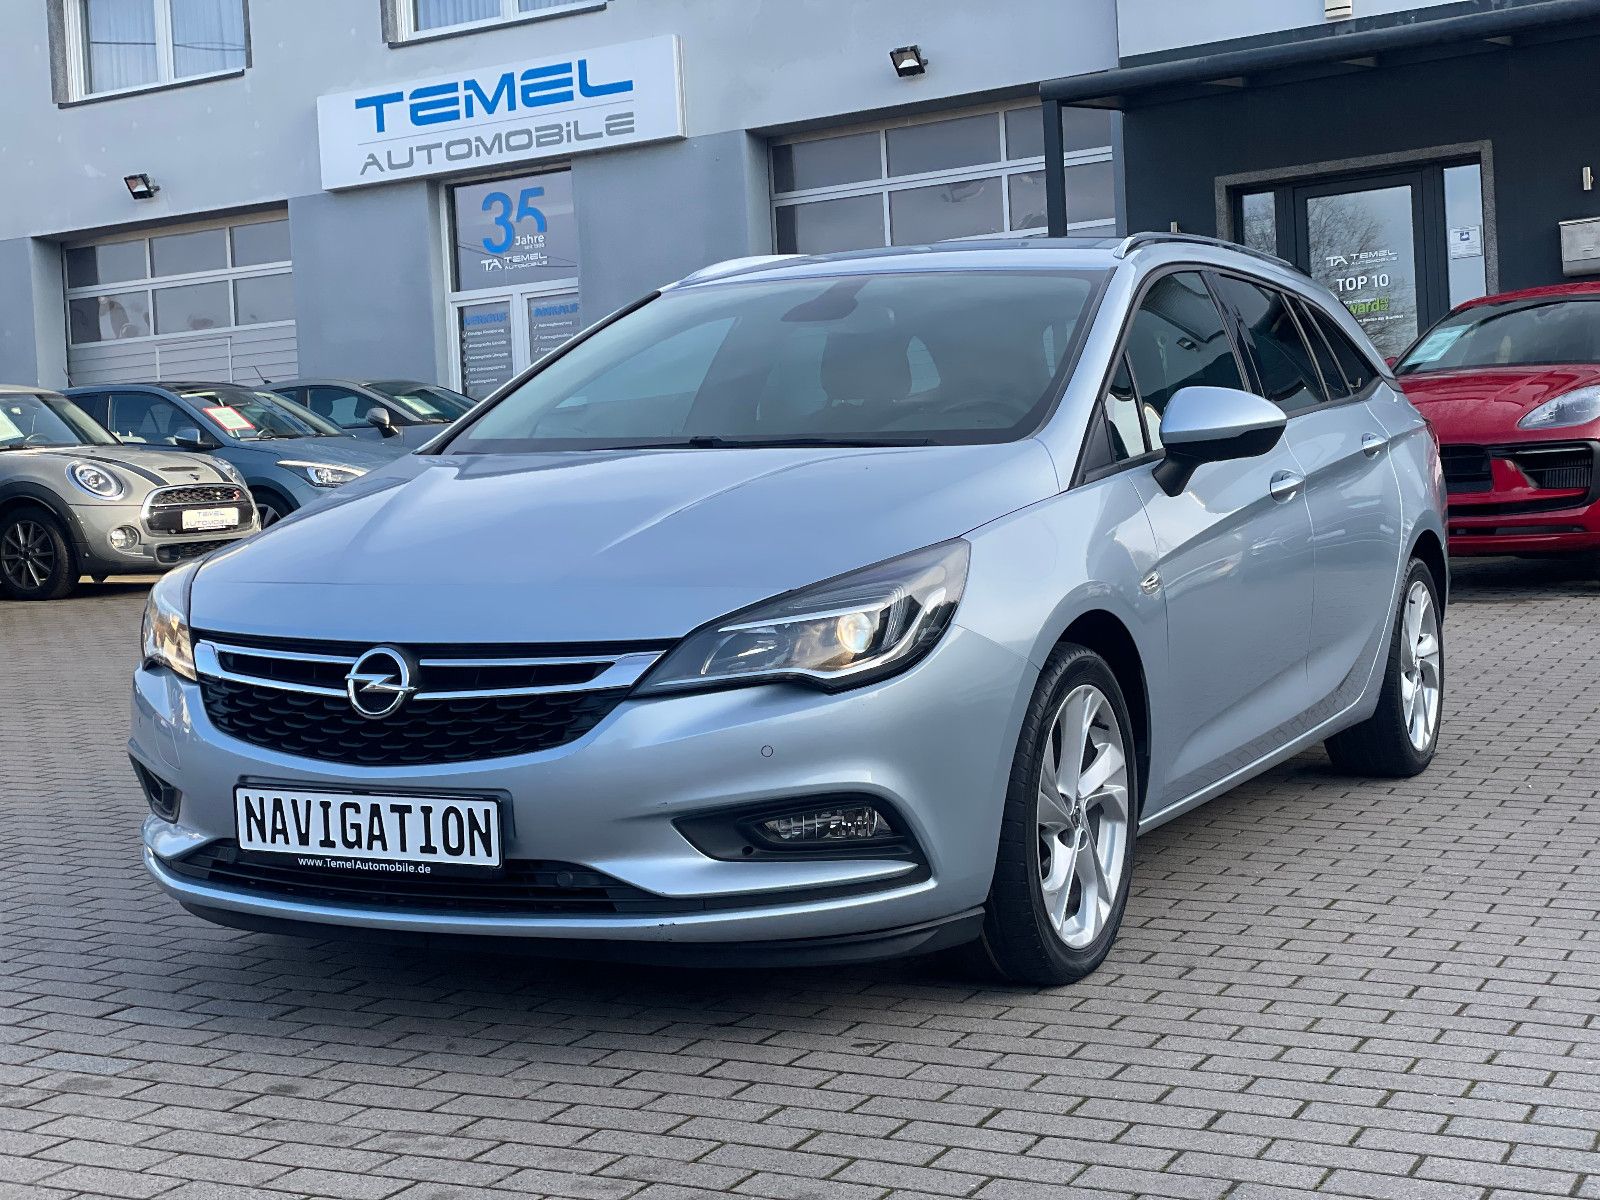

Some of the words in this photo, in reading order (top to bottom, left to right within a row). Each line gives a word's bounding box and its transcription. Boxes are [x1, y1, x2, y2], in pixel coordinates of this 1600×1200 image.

[354, 59, 634, 133] TEMEL
[481, 186, 548, 254] 35
[515, 234, 545, 246] Jahre
[504, 252, 548, 263] TEMEL
[1325, 255, 1349, 267] TA
[1350, 249, 1398, 260] TEMEL
[480, 258, 502, 271] TA
[1336, 276, 1368, 292] TOP
[1371, 273, 1390, 288] 10
[244, 795, 493, 858] NAVIGATION
[298, 857, 431, 874] www.TemelAutomobile.de
